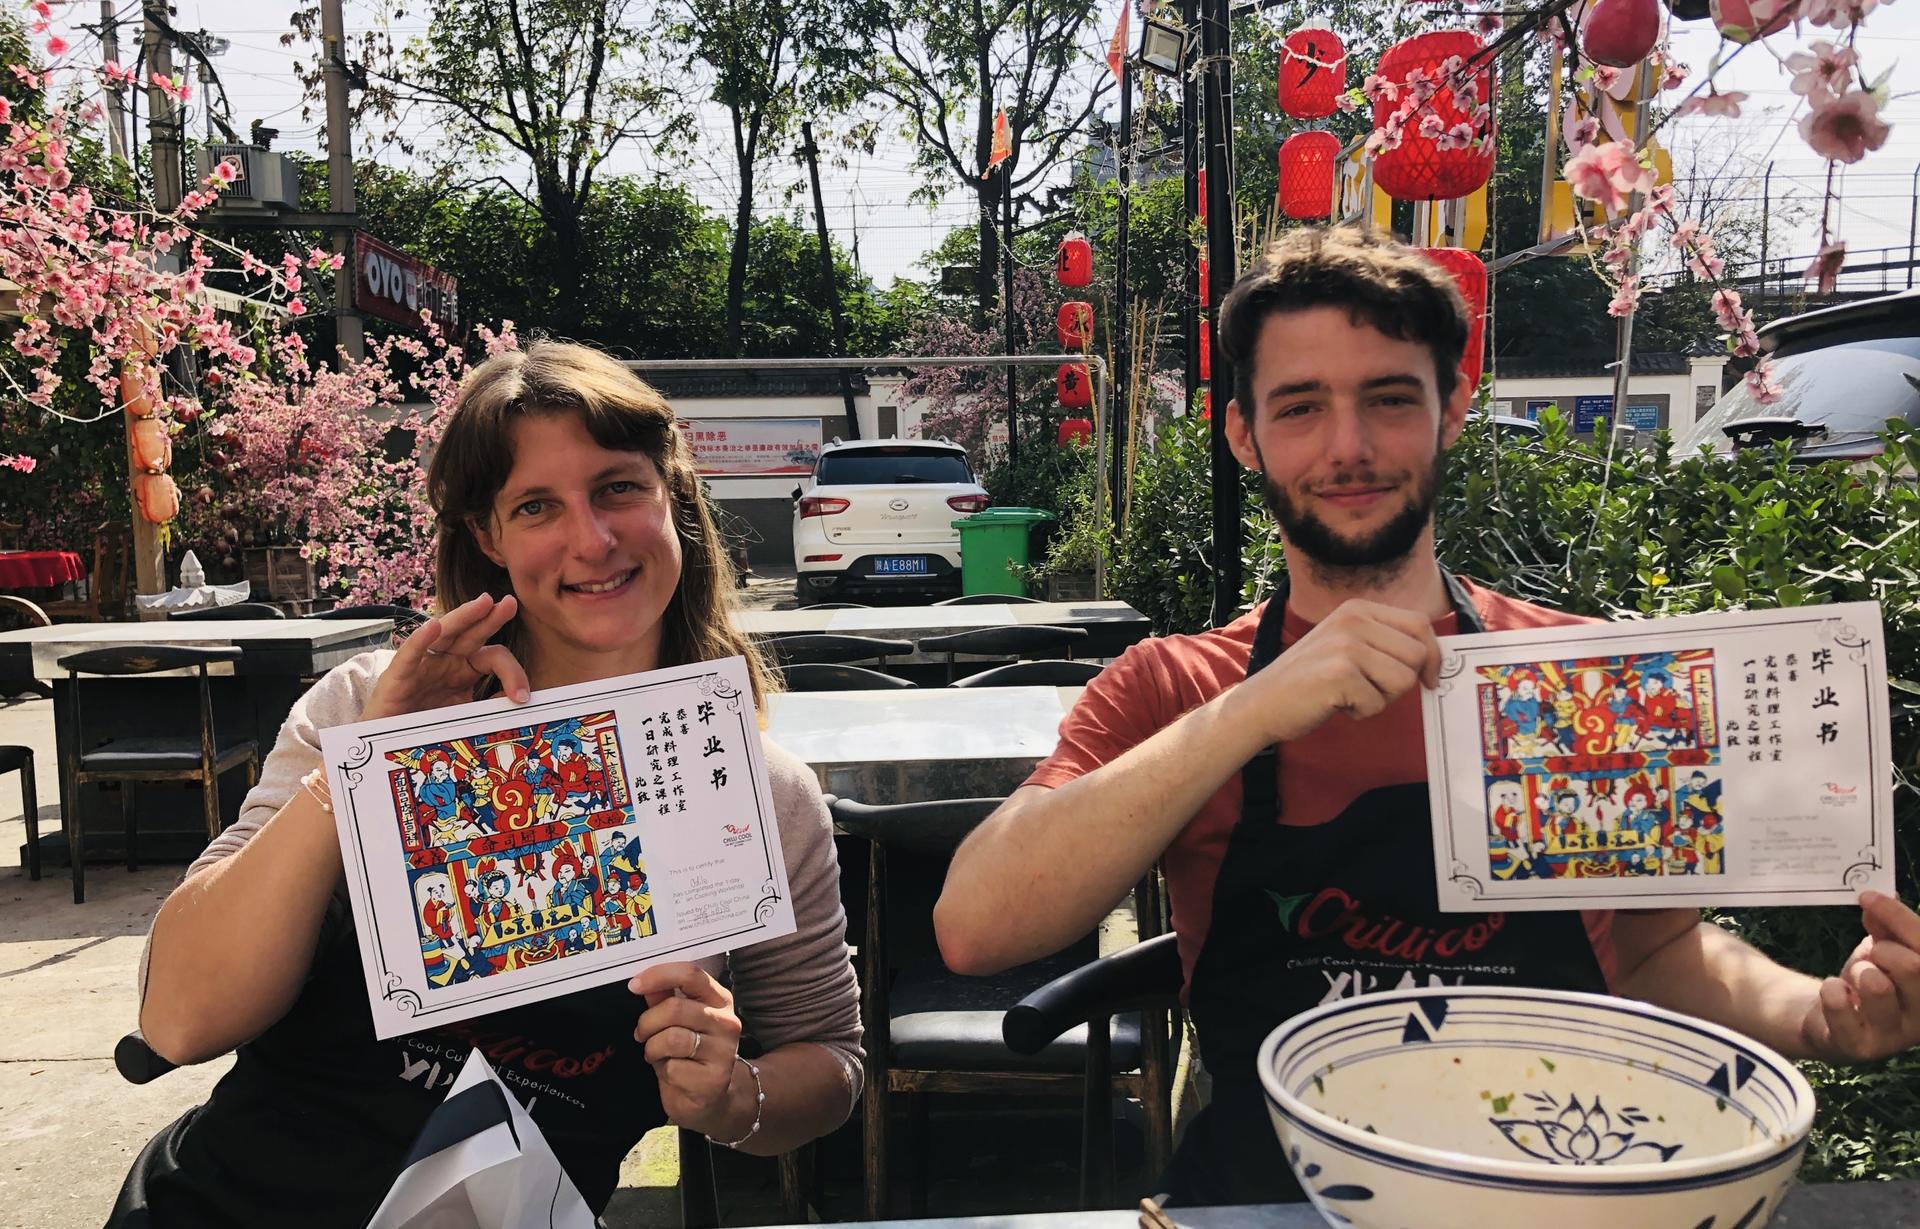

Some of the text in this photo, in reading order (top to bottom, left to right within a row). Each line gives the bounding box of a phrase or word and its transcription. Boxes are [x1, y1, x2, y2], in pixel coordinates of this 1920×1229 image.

[366, 252, 402, 303] OYO
[677, 709, 689, 735] 恭喜
[1811, 648, 1839, 745] 毕业书
[642, 717, 670, 816] 一日研究之课程
[659, 712, 687, 813] 完成料理工作室
[697, 701, 727, 790] 毕业书
[635, 777, 650, 804] 此致
[738, 832, 752, 840] COOL
[506, 1069, 586, 1109] Experiences
